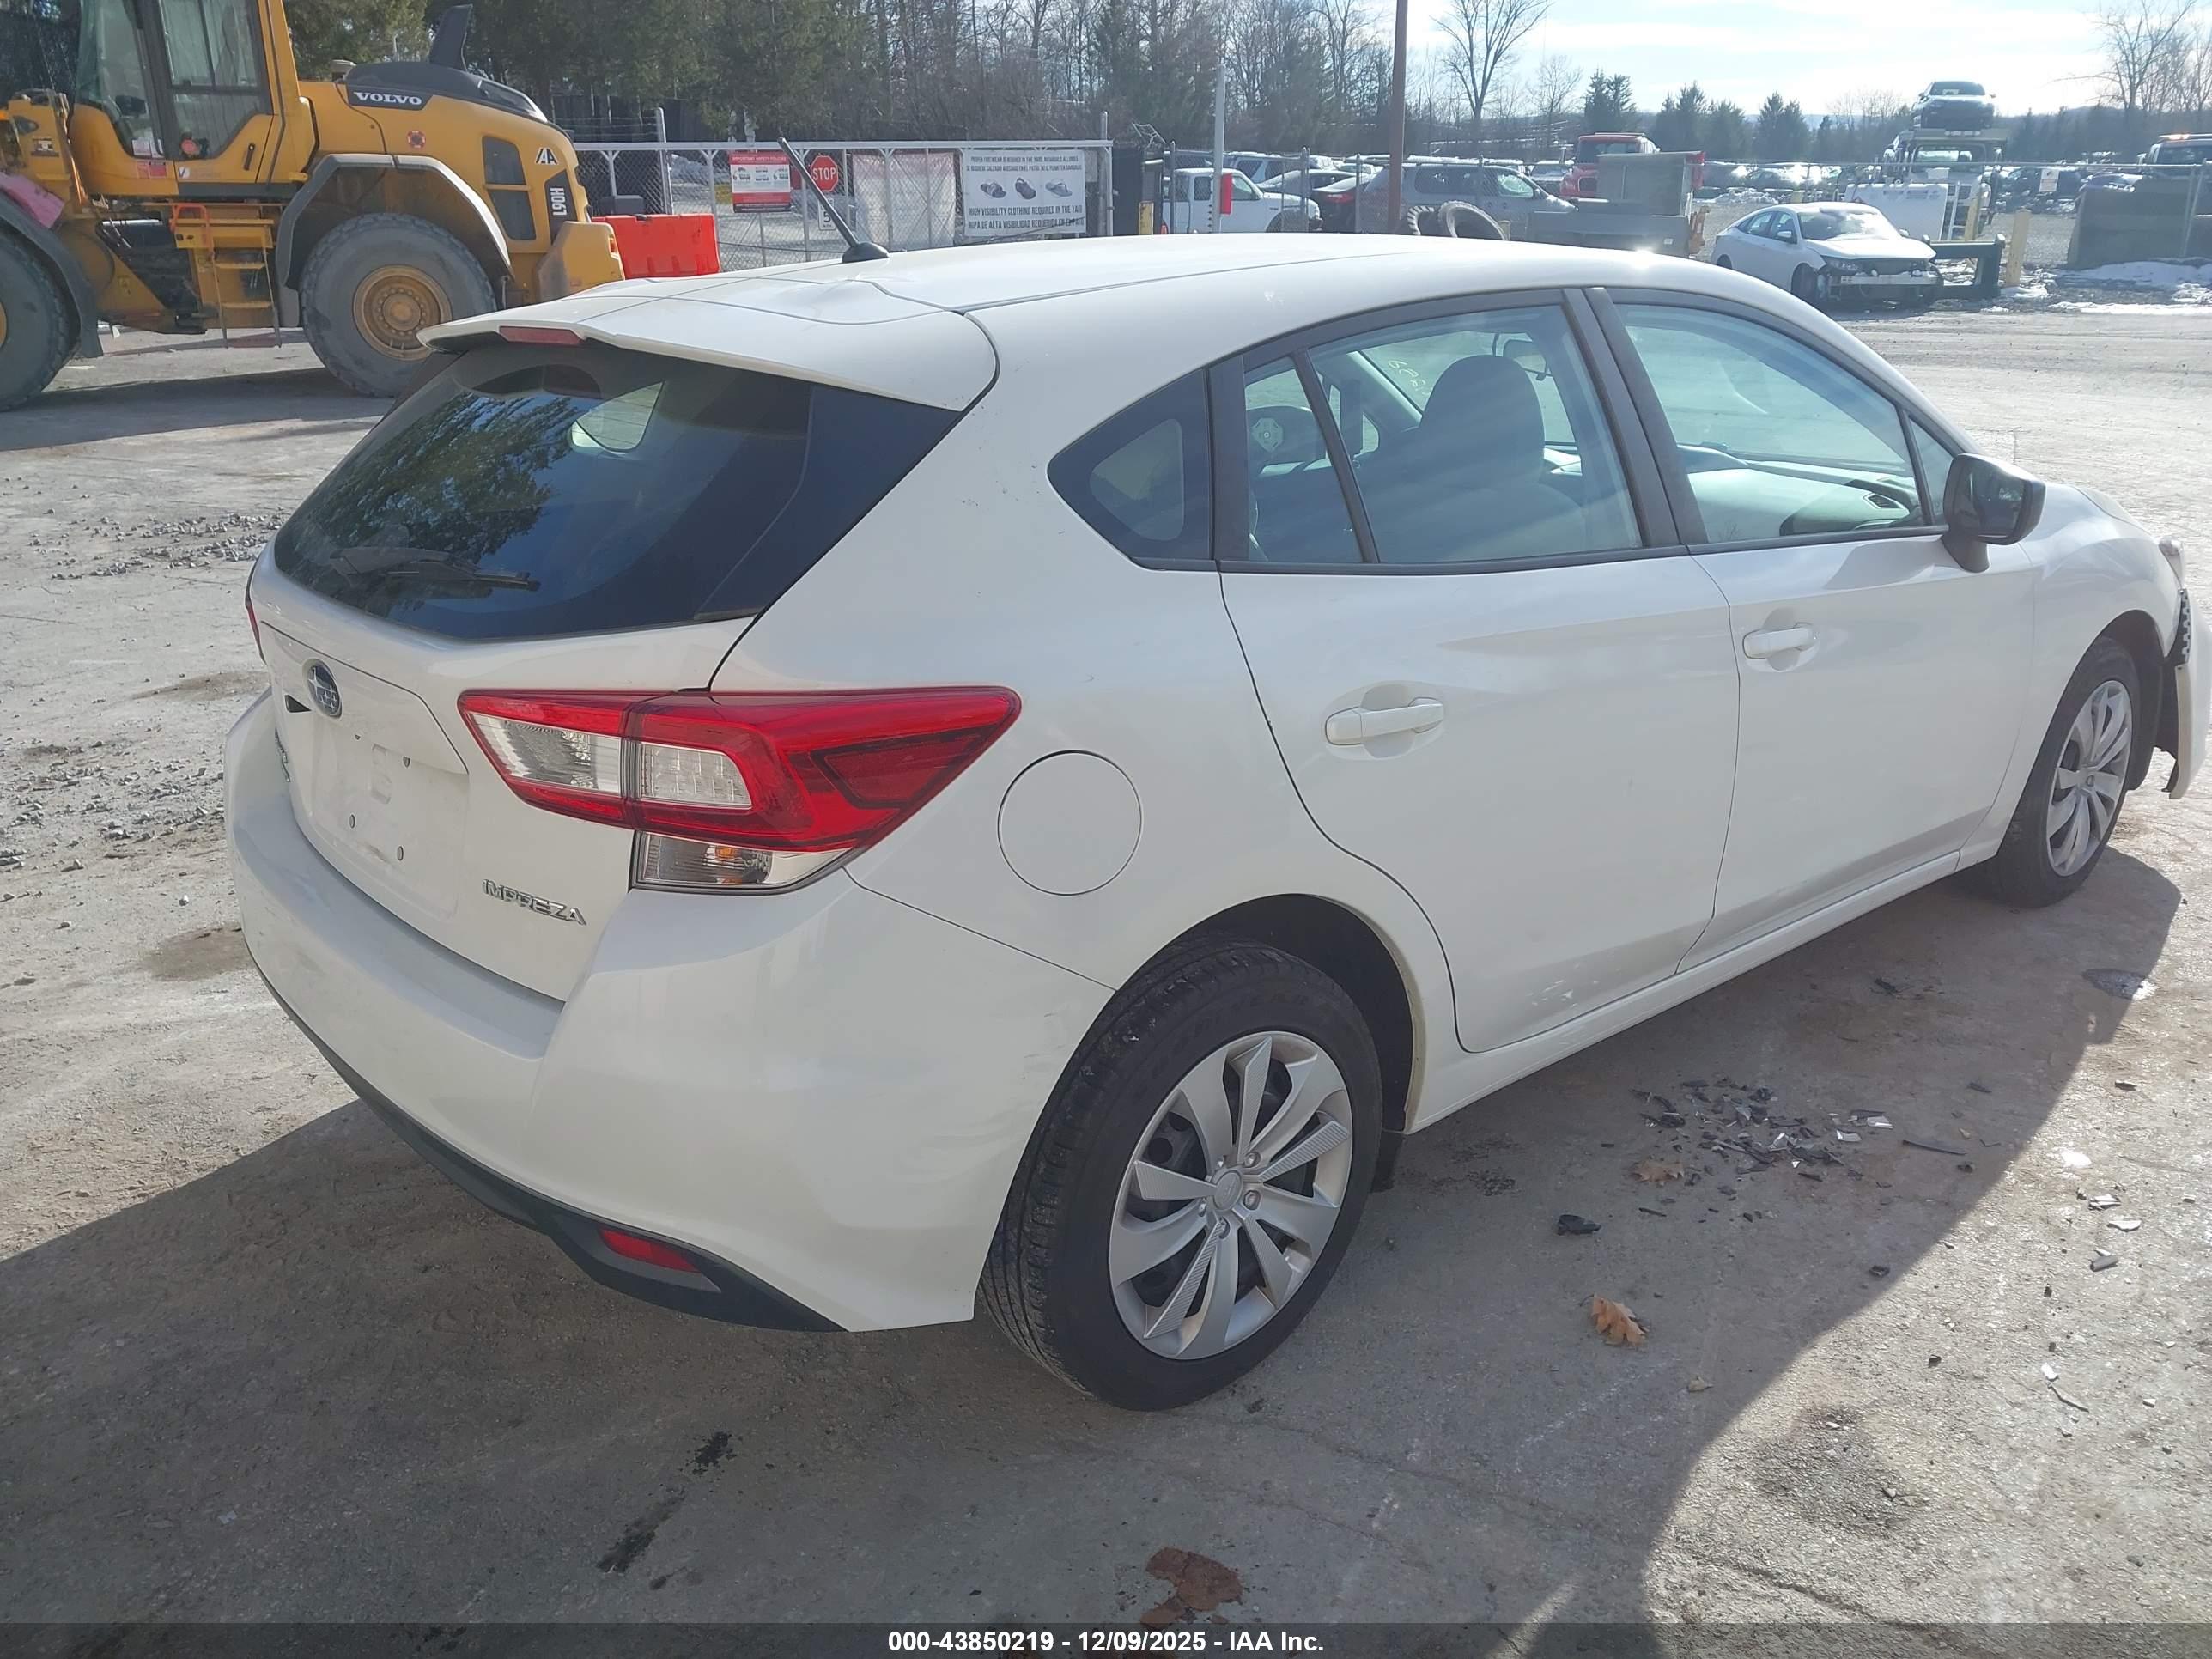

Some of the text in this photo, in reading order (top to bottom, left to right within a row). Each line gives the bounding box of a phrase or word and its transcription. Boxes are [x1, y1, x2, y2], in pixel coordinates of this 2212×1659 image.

[353, 91, 422, 105] VOLVO
[812, 167, 836, 180] STOP
[550, 186, 568, 216] L90H
[823, 211, 831, 223] 5
[981, 207, 1007, 216] VISIBILITY
[1007, 207, 1030, 216] CLOTHING
[1031, 206, 1055, 215] REQUIRED
[1061, 205, 1071, 214] THE
[988, 220, 1002, 229] ALTA
[482, 879, 587, 926] IMPREZA
